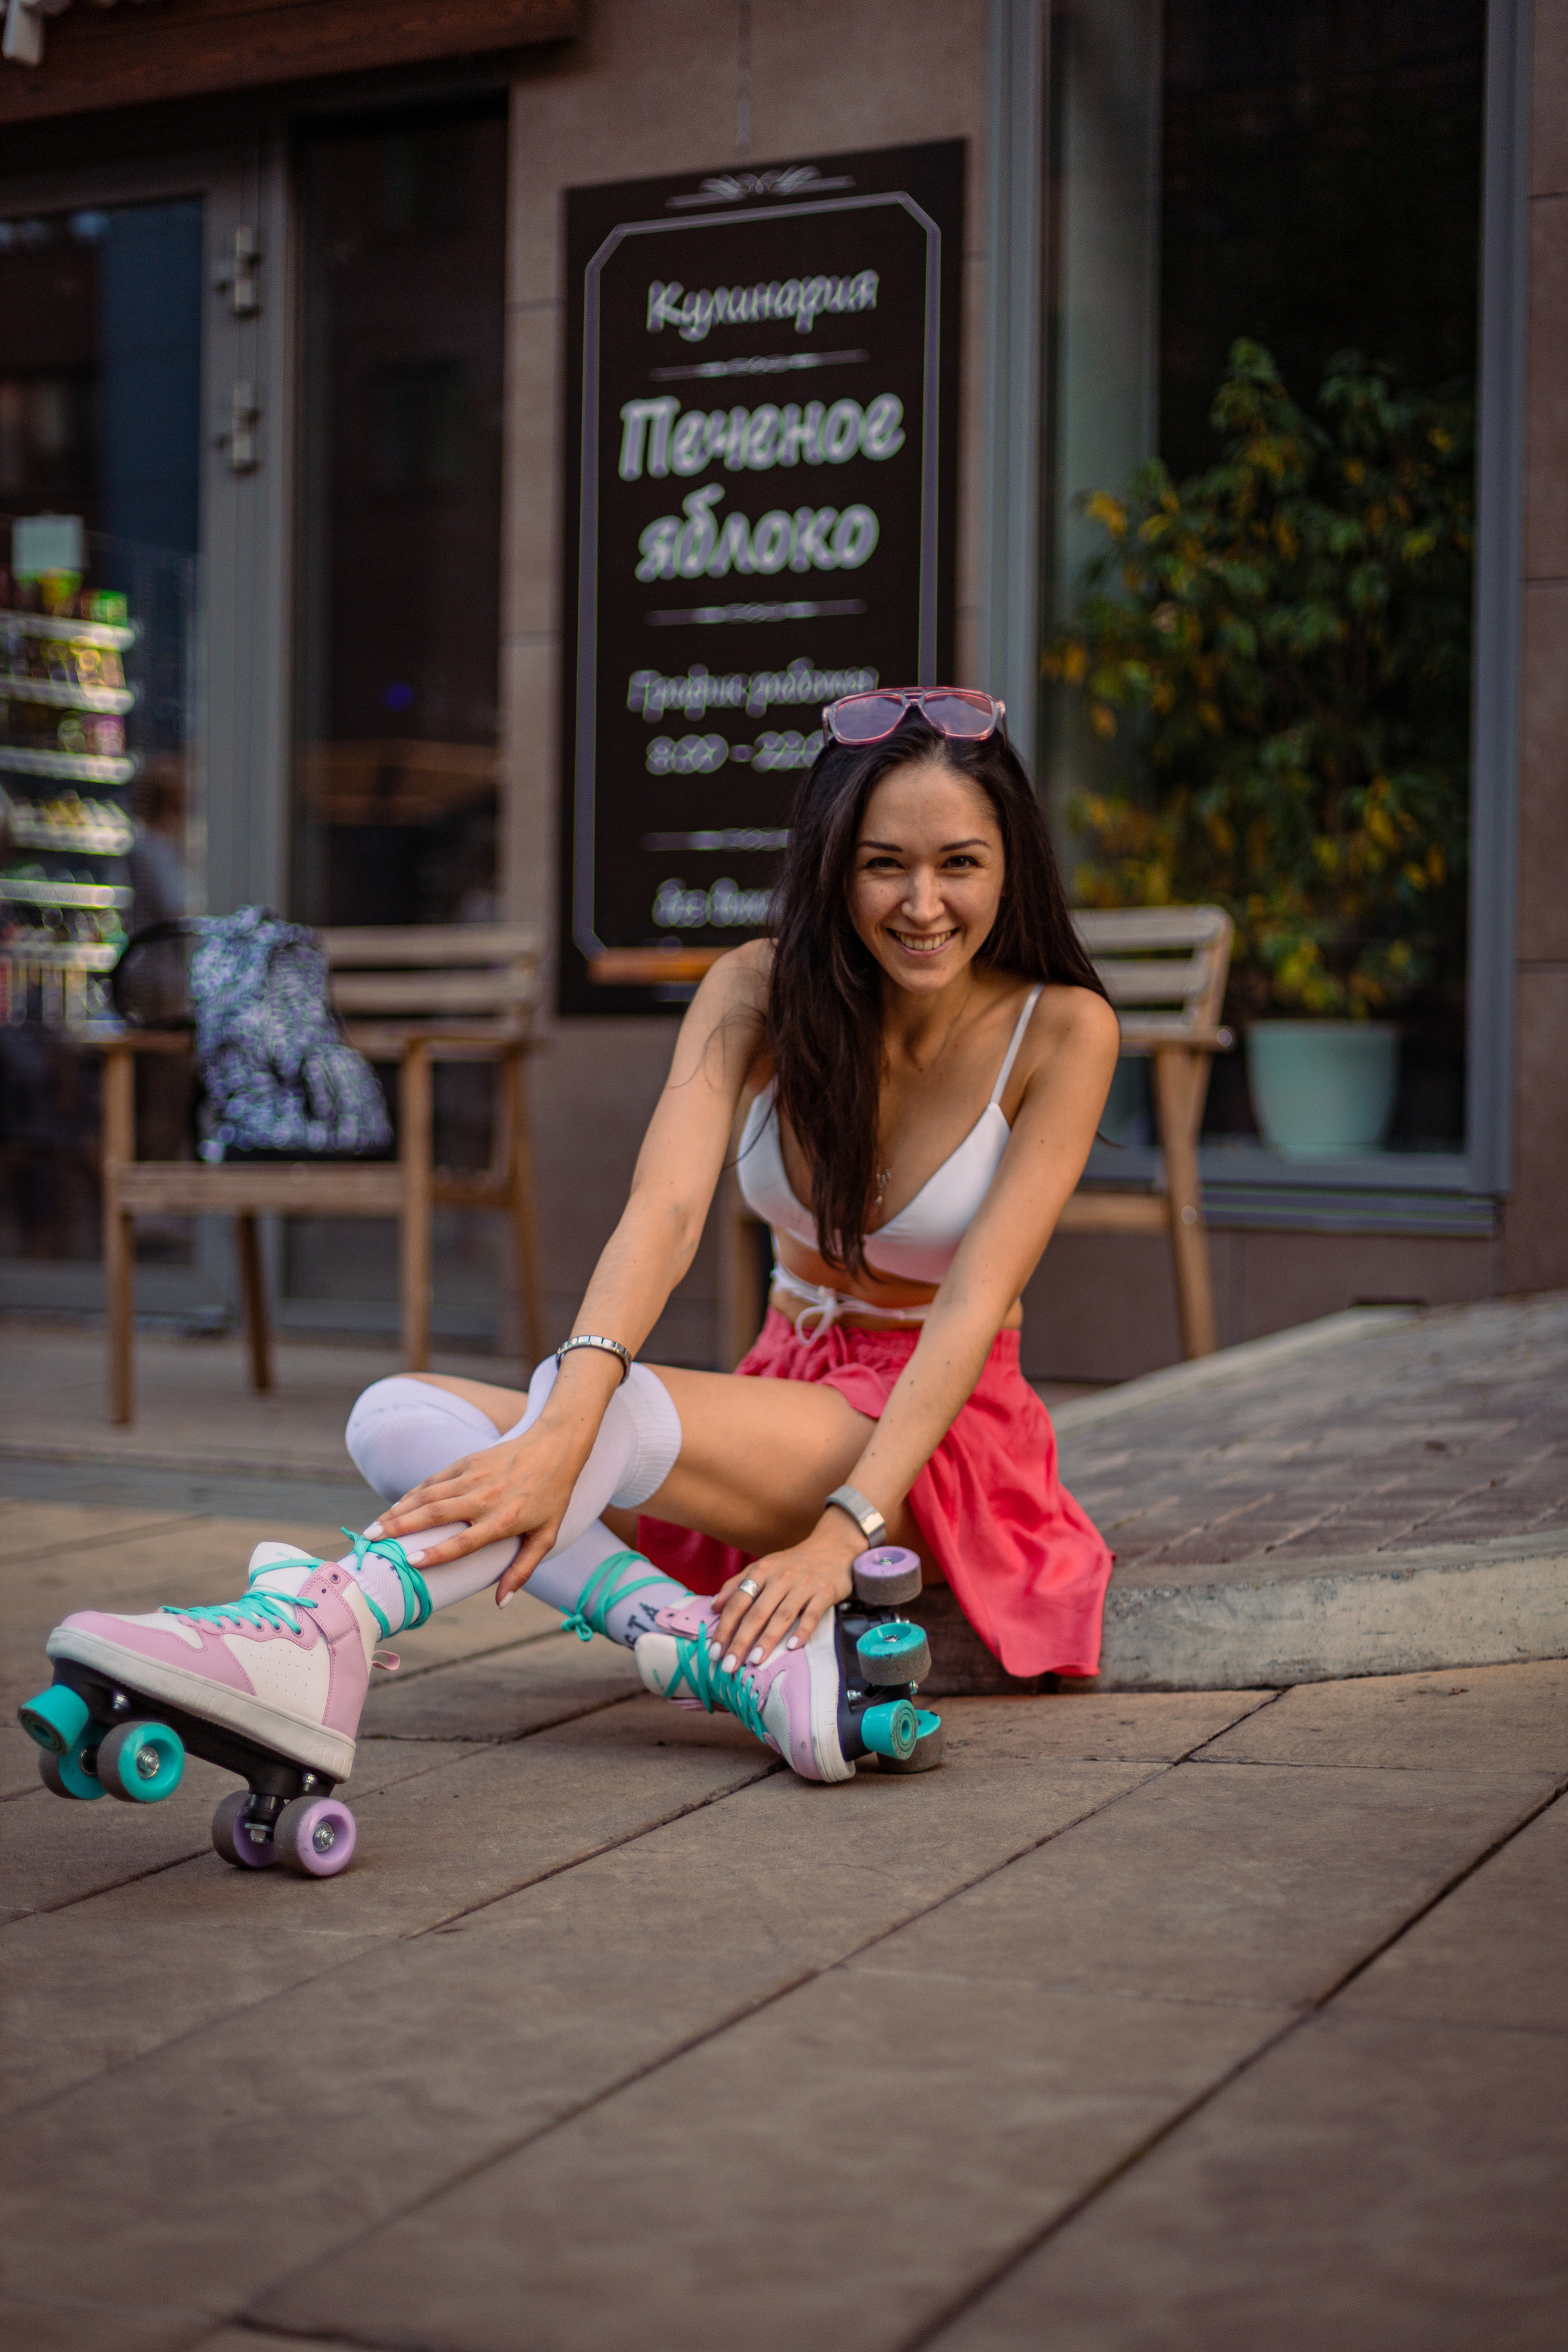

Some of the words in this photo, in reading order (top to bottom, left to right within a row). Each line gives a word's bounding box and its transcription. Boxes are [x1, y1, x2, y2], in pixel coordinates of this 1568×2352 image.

[647, 270, 880, 342] Кулинария
[619, 393, 905, 481] Печеное
[635, 483, 880, 582] яблоко
